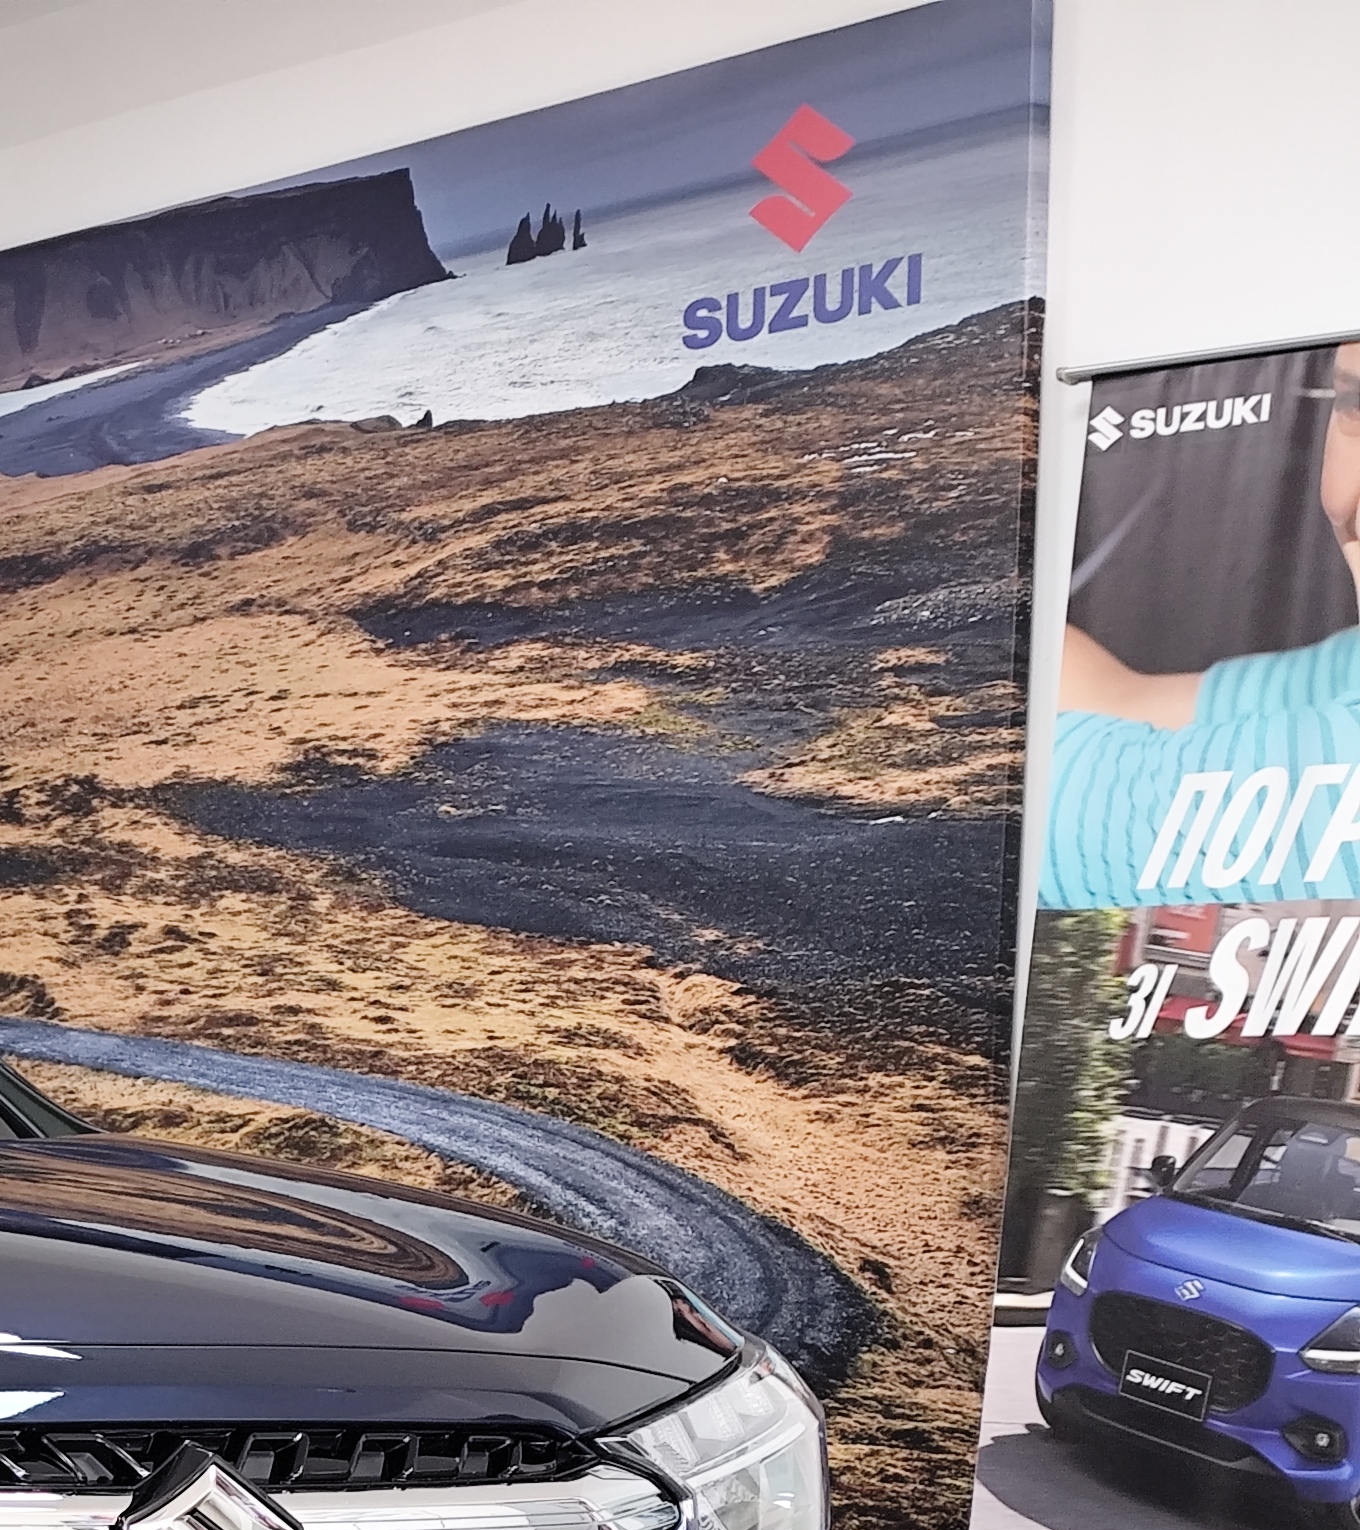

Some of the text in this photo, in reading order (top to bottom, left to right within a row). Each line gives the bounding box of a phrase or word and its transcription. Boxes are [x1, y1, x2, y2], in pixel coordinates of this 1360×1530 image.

[682, 253, 923, 349] SUZUKI
[1128, 392, 1272, 440] SUZUKI
[1125, 1368, 1203, 1401] SWIFT
